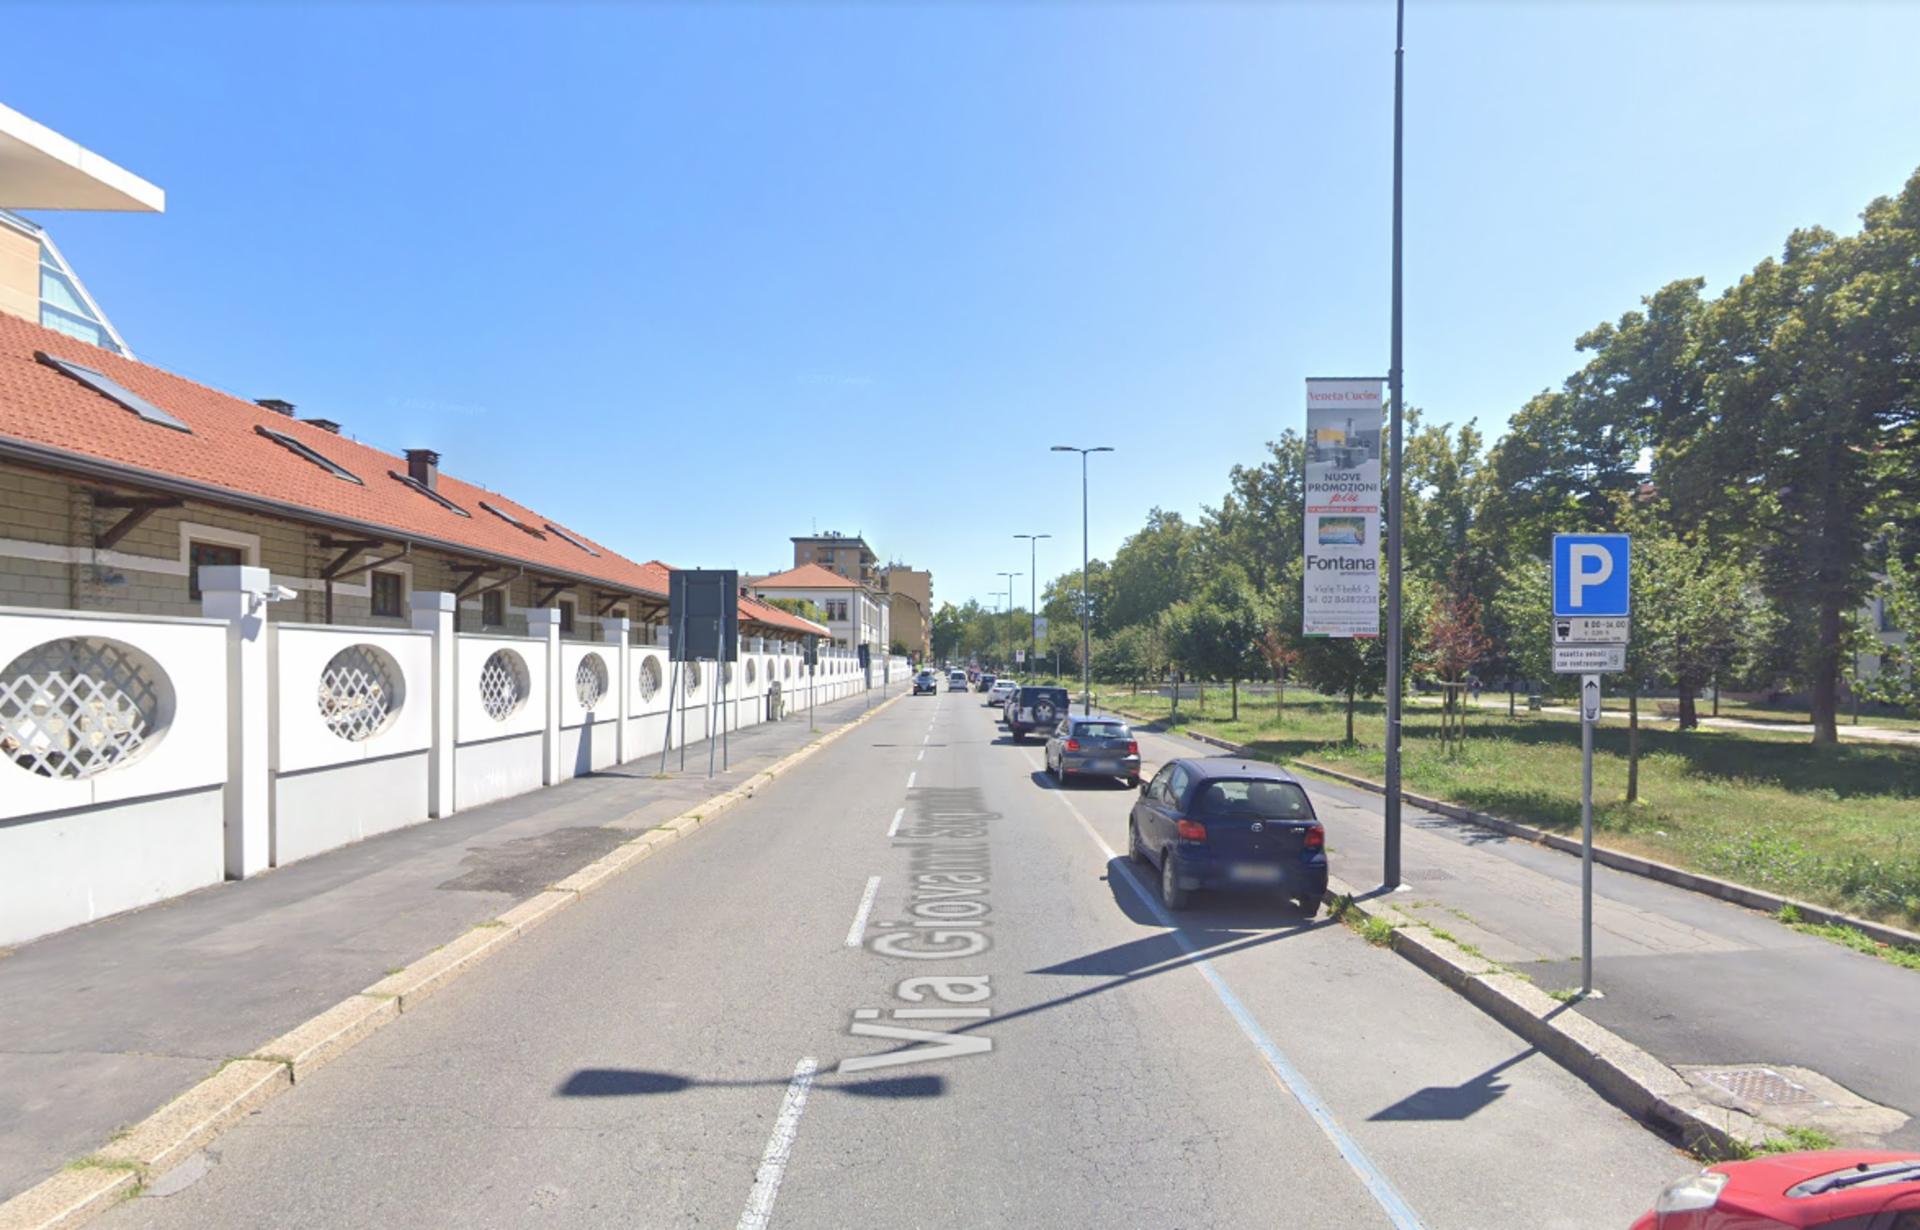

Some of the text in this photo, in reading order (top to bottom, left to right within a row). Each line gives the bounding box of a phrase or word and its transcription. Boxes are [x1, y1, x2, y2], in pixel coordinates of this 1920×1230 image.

[1309, 391, 1344, 401] Veneta
[1325, 473, 1361, 481] NUOVE
[1308, 483, 1377, 492] PROMOZIONI
[1307, 555, 1376, 570] Fontana
[1570, 543, 1614, 608] P
